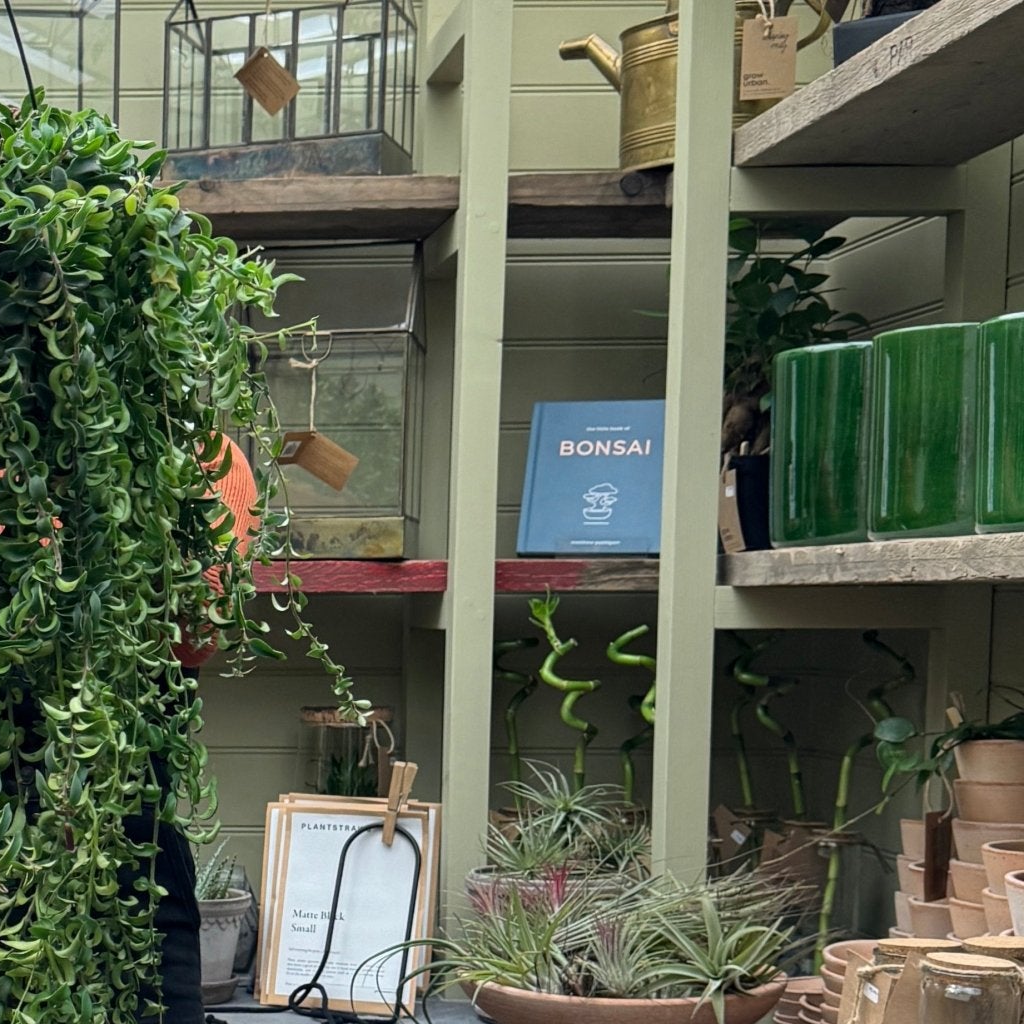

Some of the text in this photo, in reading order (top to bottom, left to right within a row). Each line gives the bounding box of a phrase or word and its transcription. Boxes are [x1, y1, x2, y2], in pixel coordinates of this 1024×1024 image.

[559, 439, 651, 456] BONSAI
[293, 909, 345, 920] Matte Blk
[291, 923, 316, 934] Small
